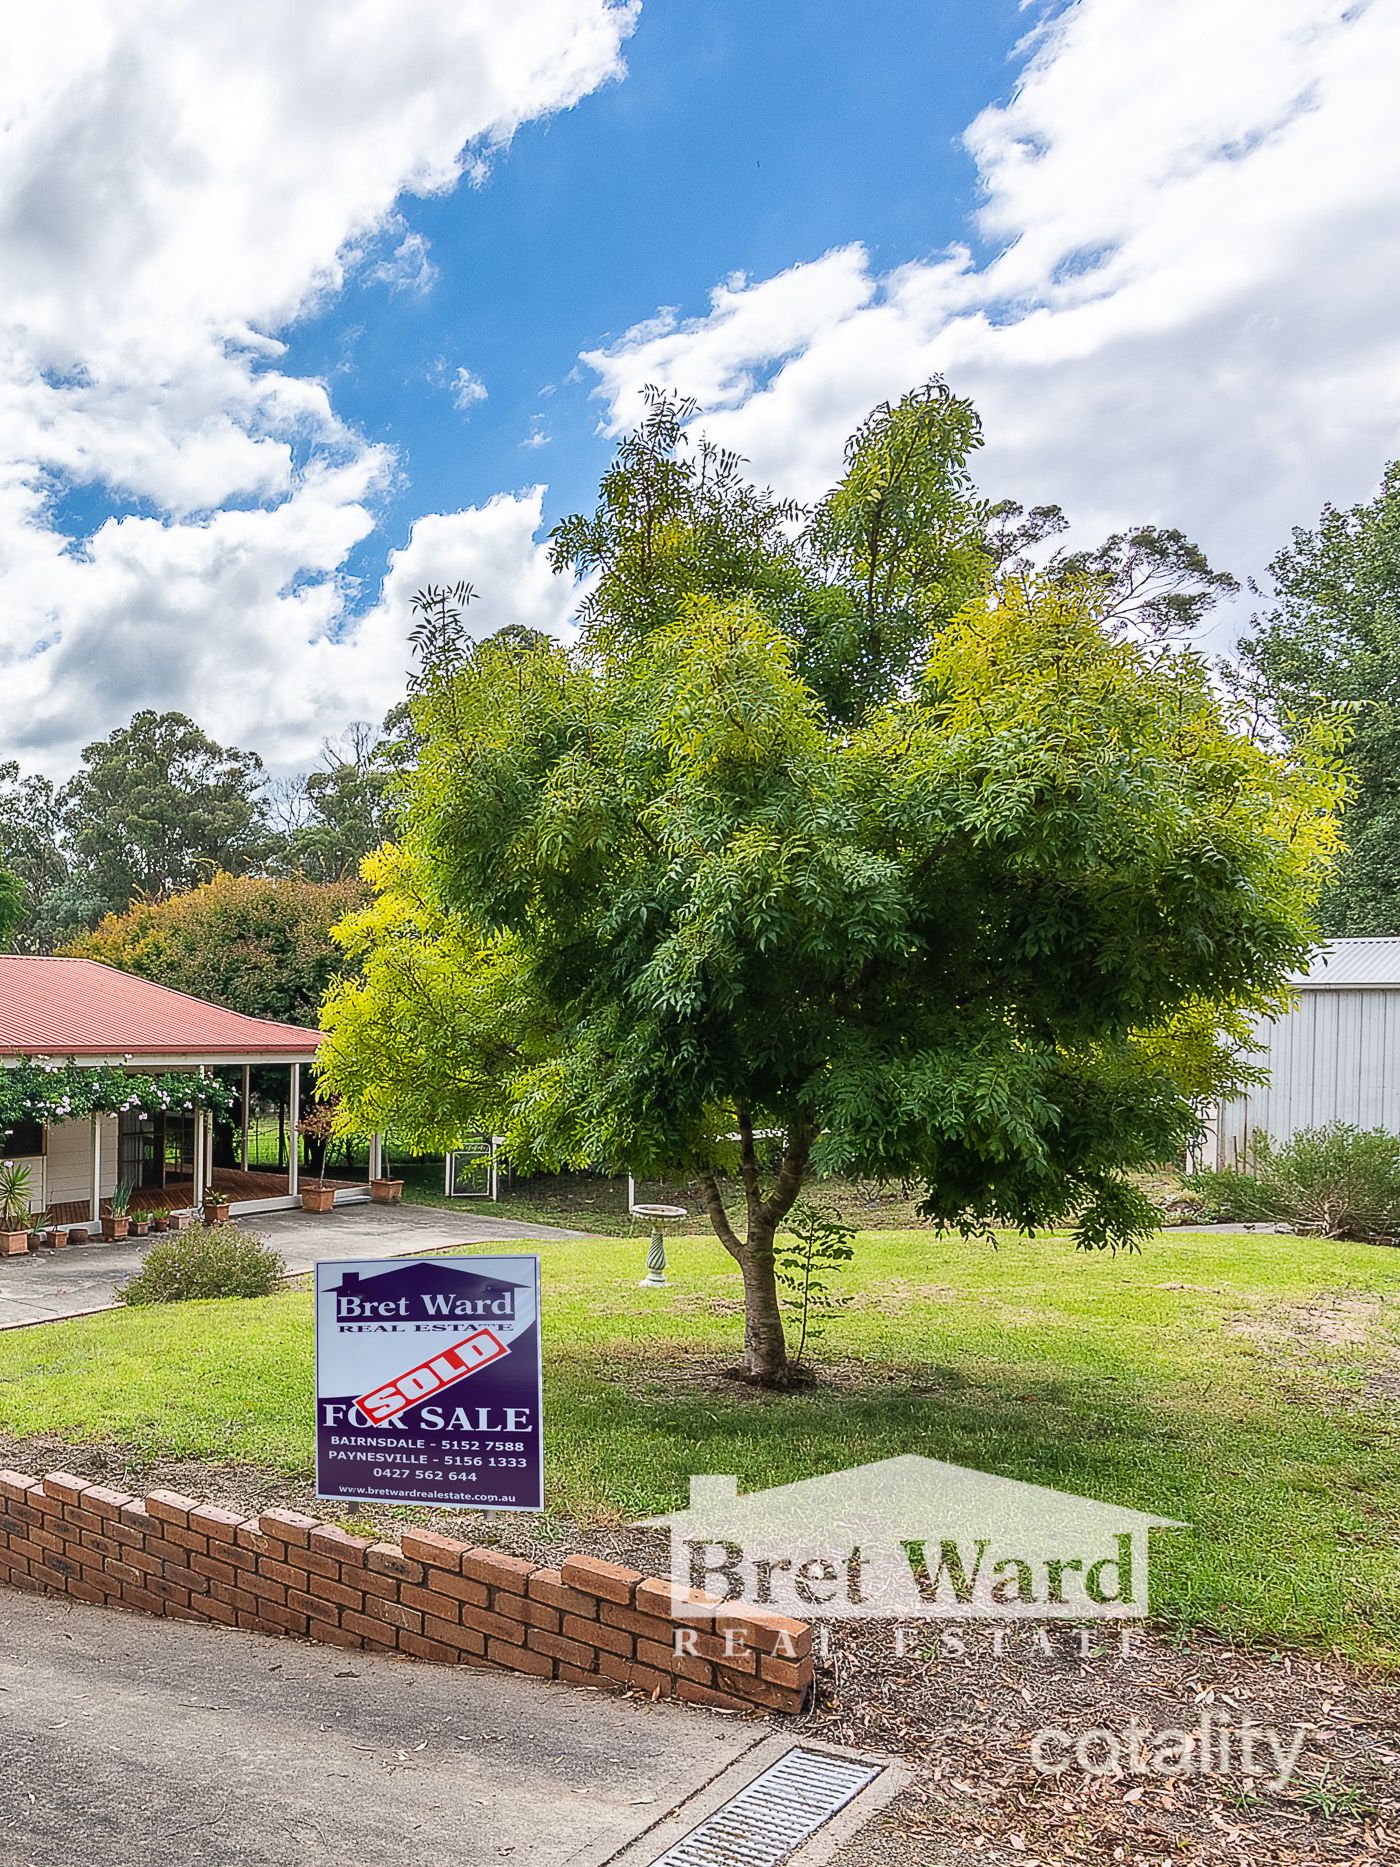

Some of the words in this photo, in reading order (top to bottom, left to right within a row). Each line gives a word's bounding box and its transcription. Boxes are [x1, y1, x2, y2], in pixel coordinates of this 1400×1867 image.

[338, 1295, 410, 1317] Bret
[420, 1292, 514, 1316] Ward
[339, 1324, 405, 1333] REAL
[363, 1333, 500, 1419] SOLD
[420, 1407, 533, 1432] SALE
[331, 1436, 425, 1449] BAIRNSDALE
[441, 1440, 480, 1451] 5152
[486, 1441, 525, 1452] 7588
[329, 1450, 427, 1464] PAYNESVILLE
[444, 1456, 482, 1467] 5156
[488, 1457, 527, 1468] 1333
[374, 1468, 411, 1478] 0427
[415, 1469, 443, 1480] 562
[448, 1471, 477, 1481] 644
[339, 1485, 516, 1502] www.bretwardrealestate.com.au
